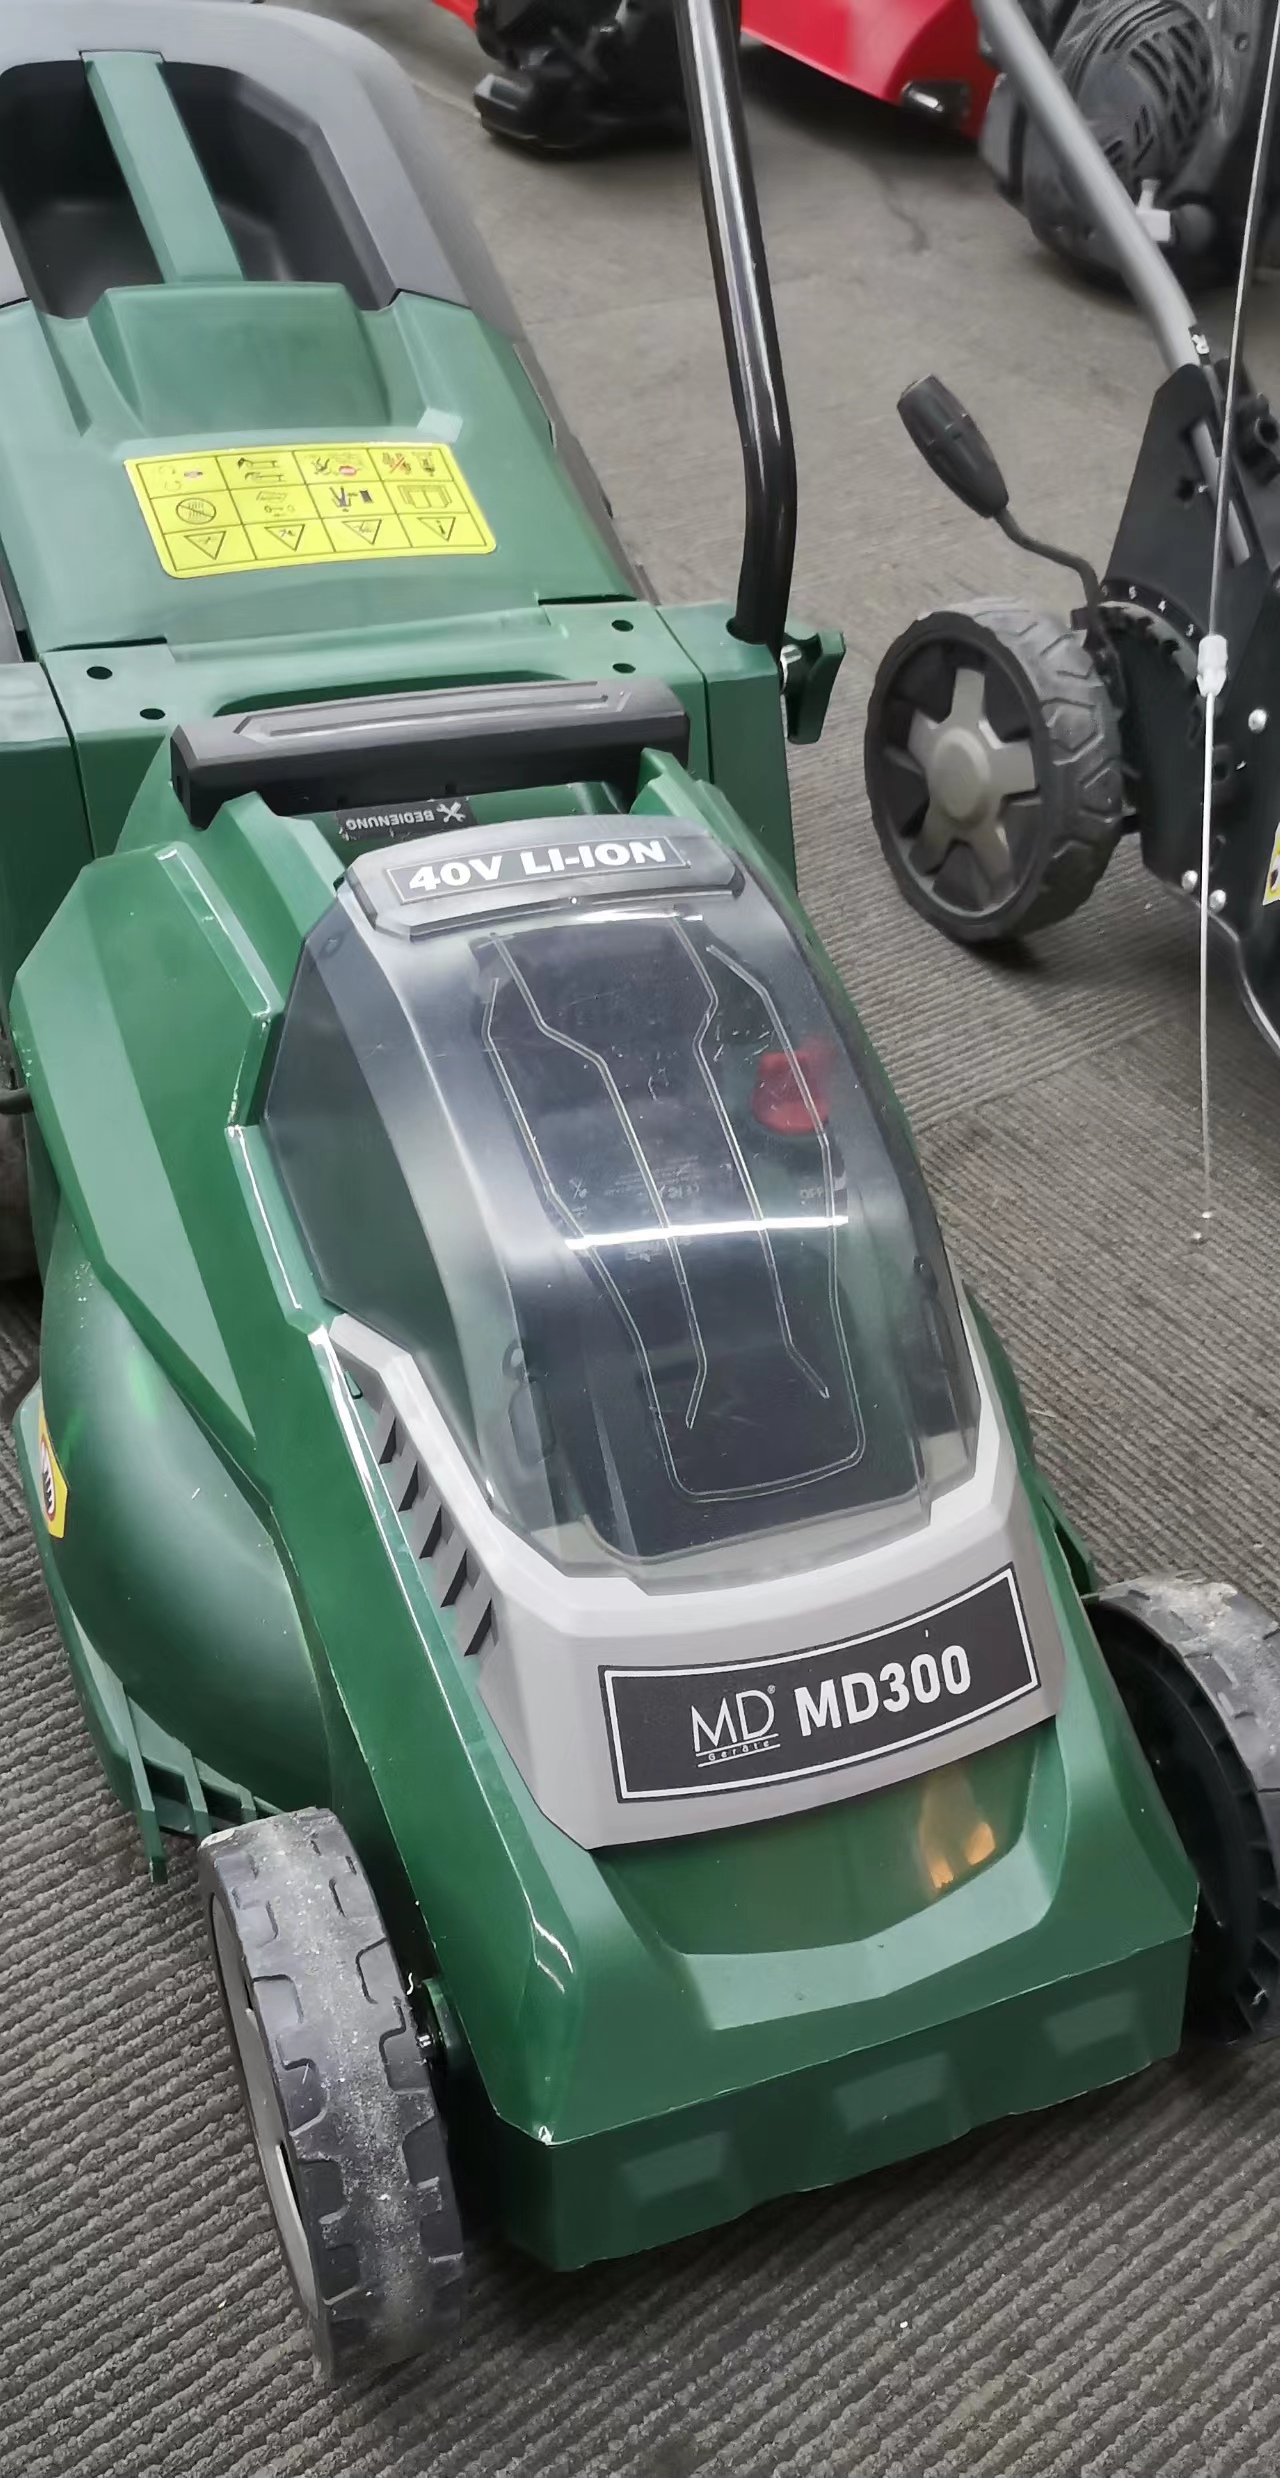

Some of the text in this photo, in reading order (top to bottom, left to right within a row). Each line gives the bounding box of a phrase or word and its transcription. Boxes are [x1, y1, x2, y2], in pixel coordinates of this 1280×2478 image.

[345, 809, 435, 831] BEDIENUNG
[408, 840, 667, 892] 40V LI-ION
[794, 1645, 971, 1737] MD300
